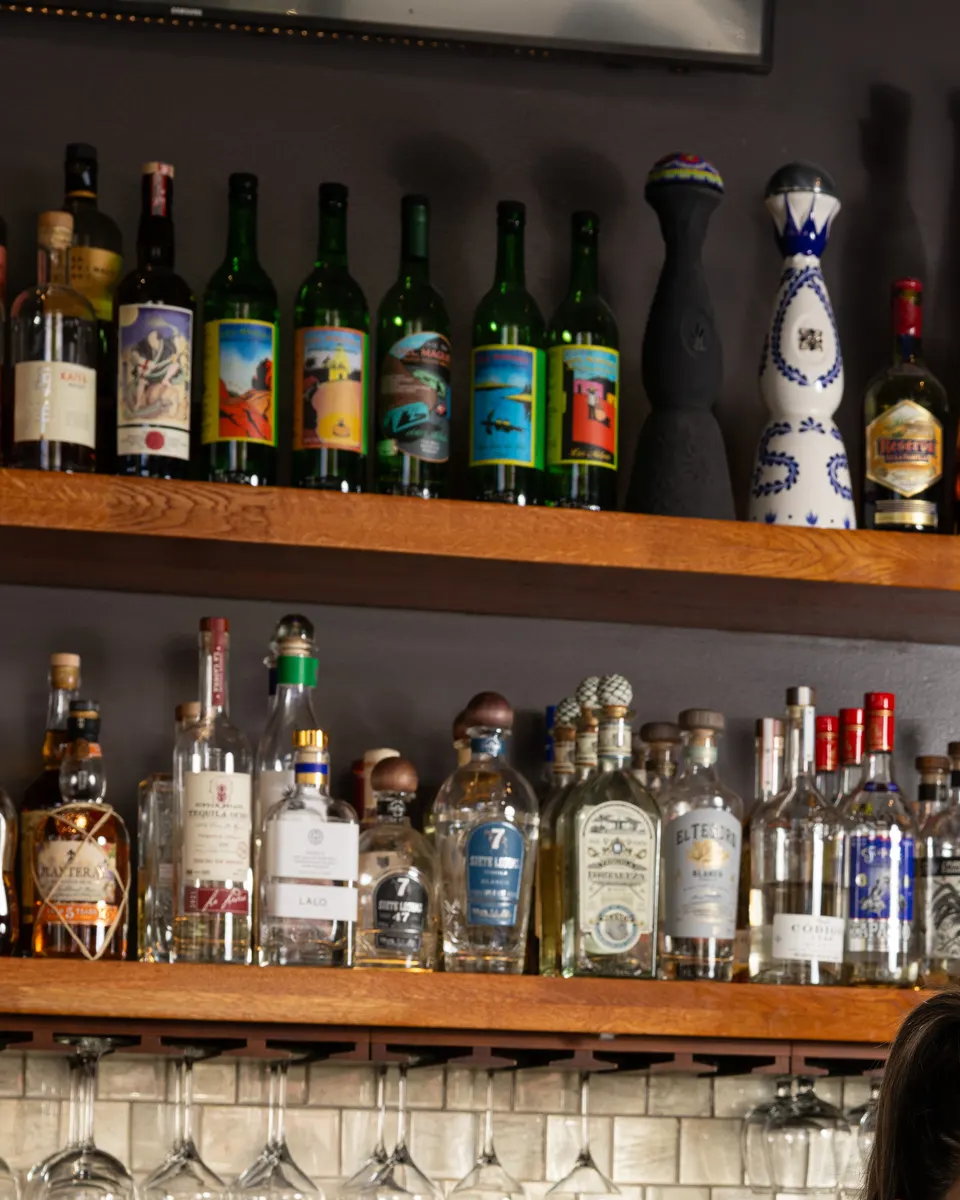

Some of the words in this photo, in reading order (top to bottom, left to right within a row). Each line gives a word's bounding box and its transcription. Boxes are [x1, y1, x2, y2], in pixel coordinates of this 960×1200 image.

[490, 827, 506, 850] 7
[397, 877, 410, 897] 7
[299, 896, 328, 907] LALO
